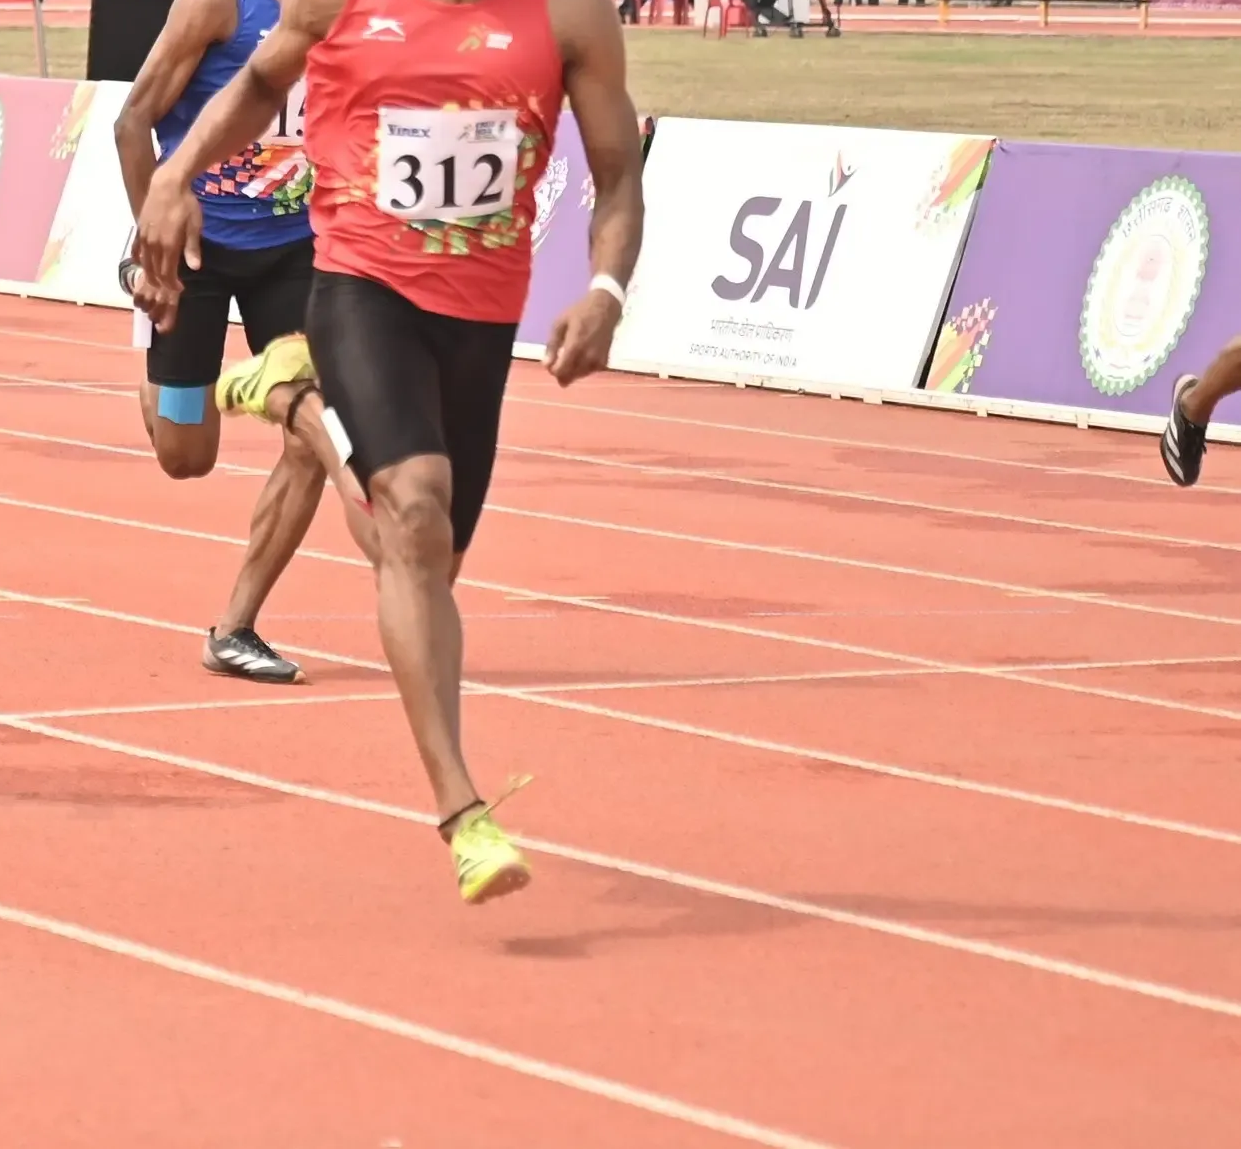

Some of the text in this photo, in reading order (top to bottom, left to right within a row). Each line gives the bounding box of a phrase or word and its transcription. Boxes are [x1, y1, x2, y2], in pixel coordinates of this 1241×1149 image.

[390, 154, 504, 210] 312
[711, 196, 847, 310] SAI
[689, 343, 798, 367] SPORTS AUTHORITY OF INDIA
